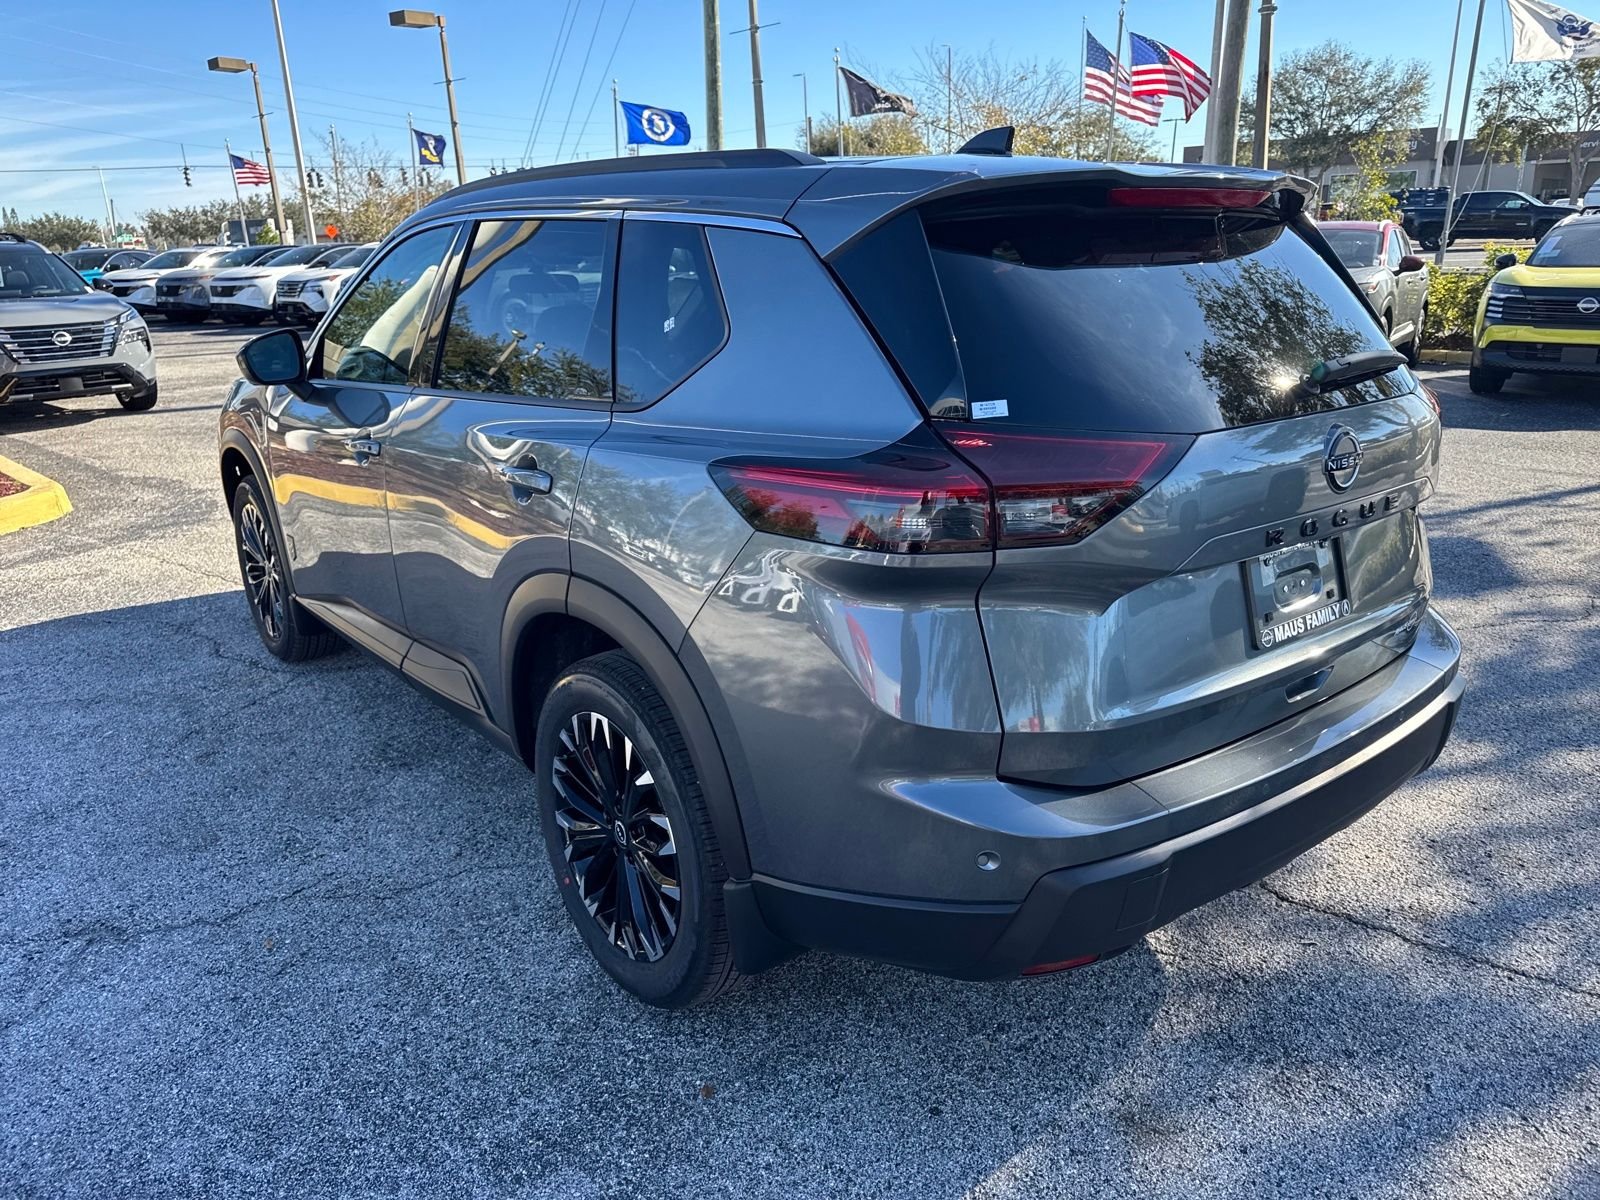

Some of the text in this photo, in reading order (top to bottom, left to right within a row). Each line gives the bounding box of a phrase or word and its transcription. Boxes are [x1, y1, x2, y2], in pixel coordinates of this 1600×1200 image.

[1265, 492, 1399, 547] ROGUE
[1274, 603, 1340, 643] MAUS FAMILY
